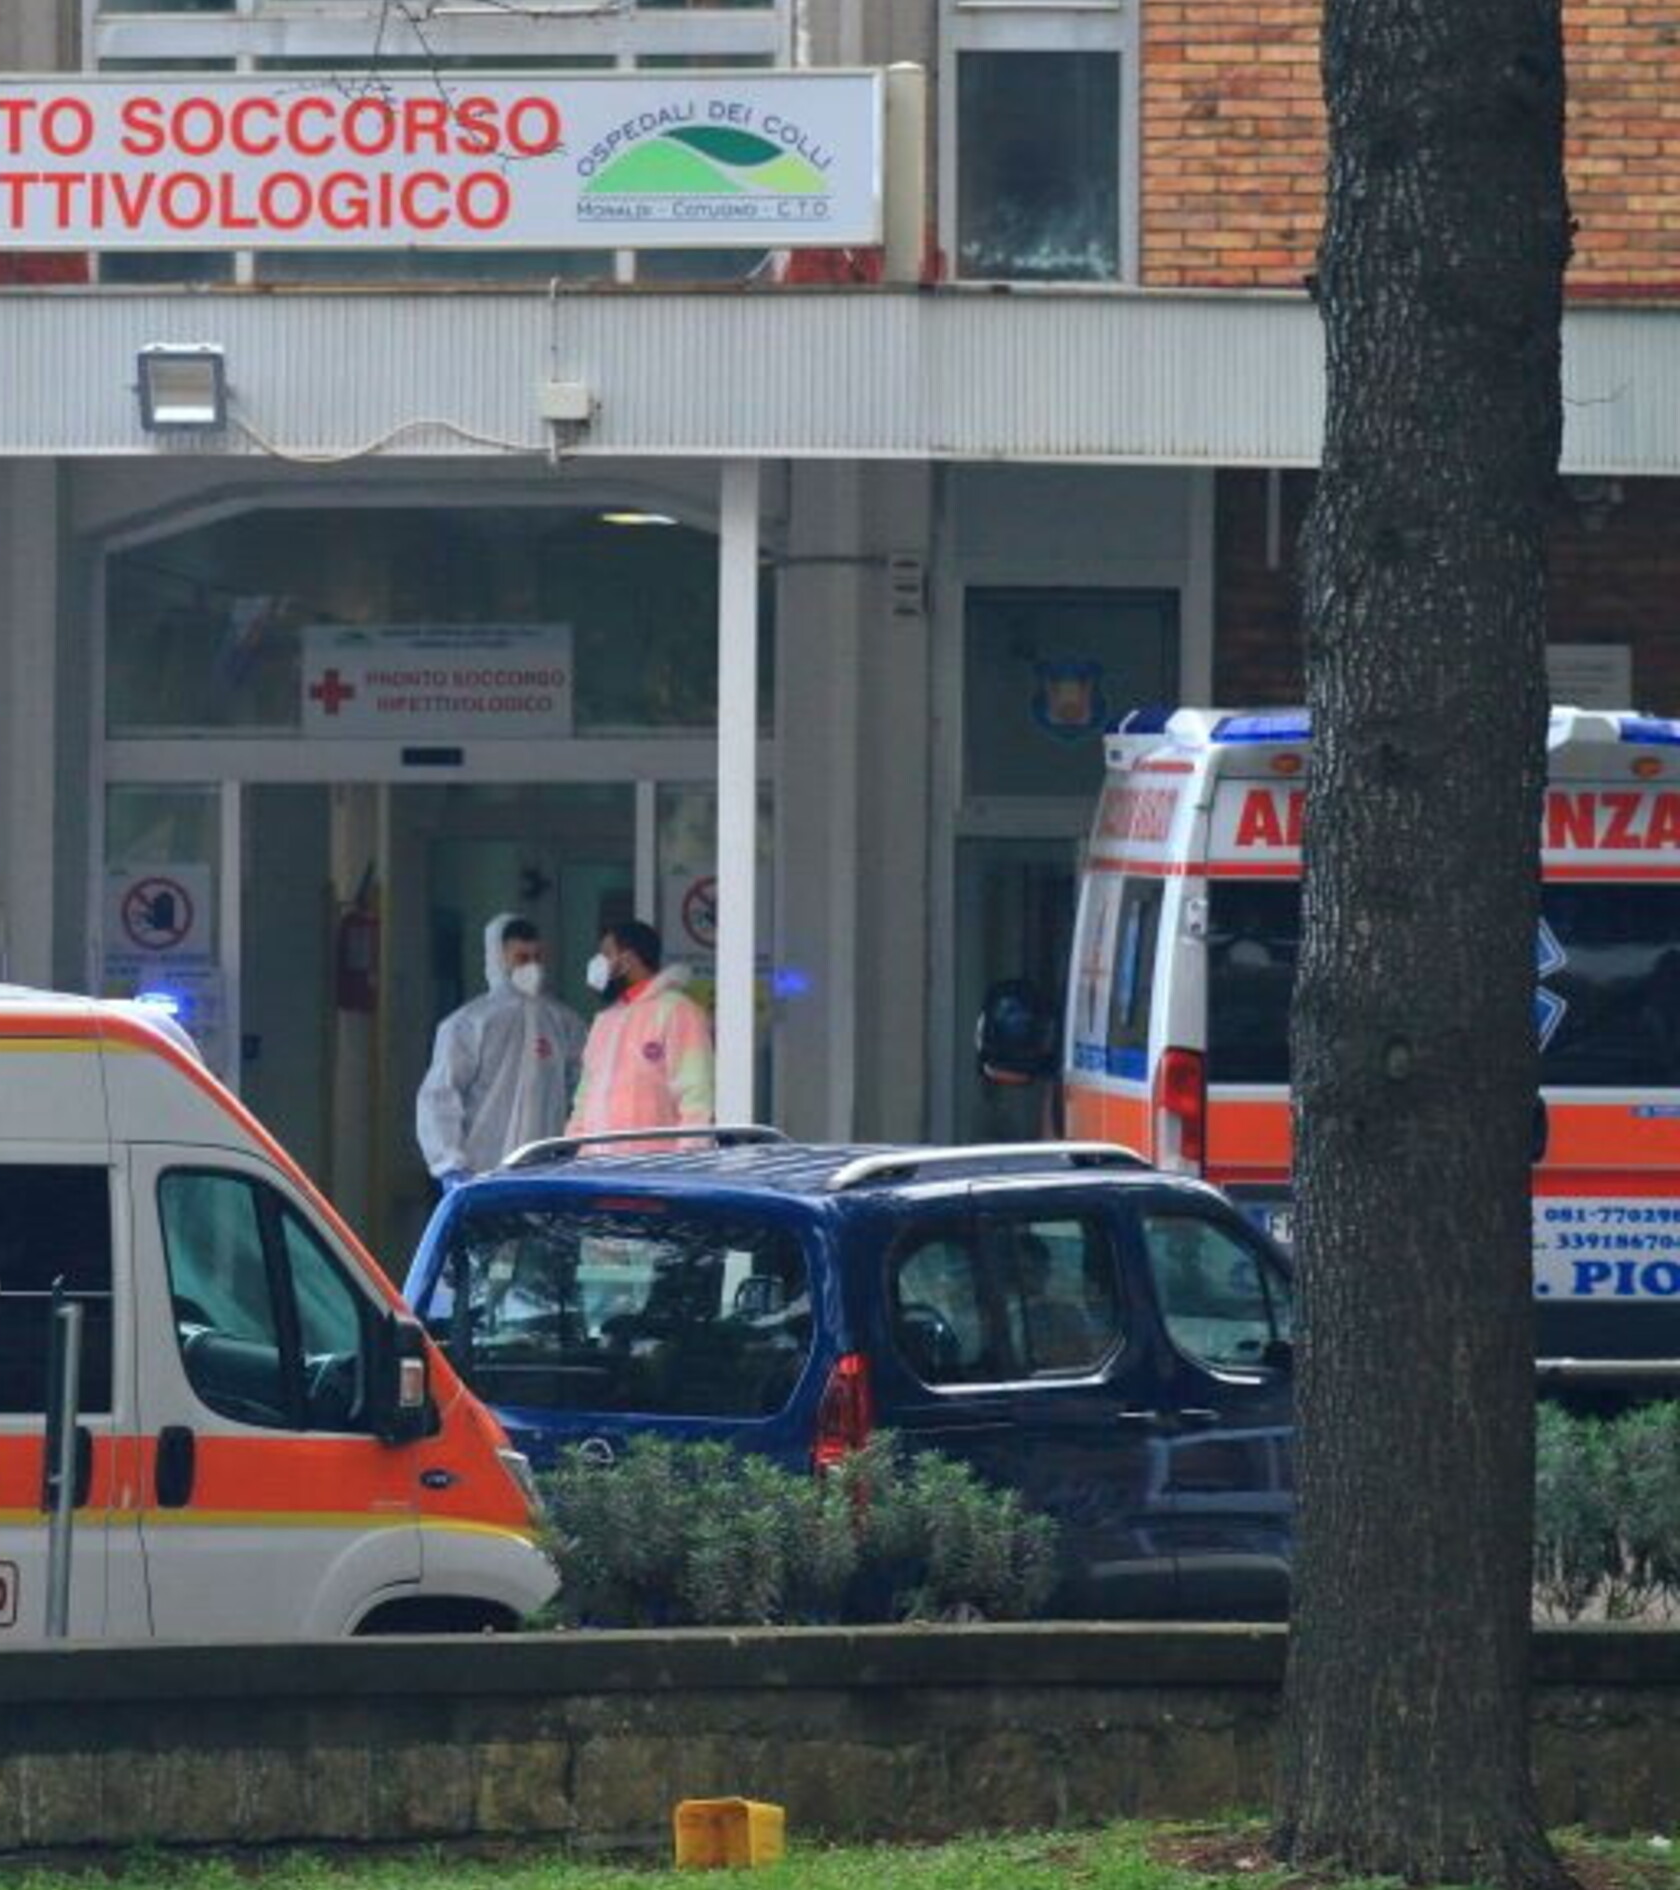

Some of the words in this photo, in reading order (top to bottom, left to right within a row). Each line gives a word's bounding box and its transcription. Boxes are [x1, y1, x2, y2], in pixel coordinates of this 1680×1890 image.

[120, 97, 561, 157] SOCCORSO
[576, 100, 694, 178] OSPEDALI
[708, 100, 752, 123] DEI
[762, 115, 833, 171] COLLI
[365, 669, 447, 687] PRONTO
